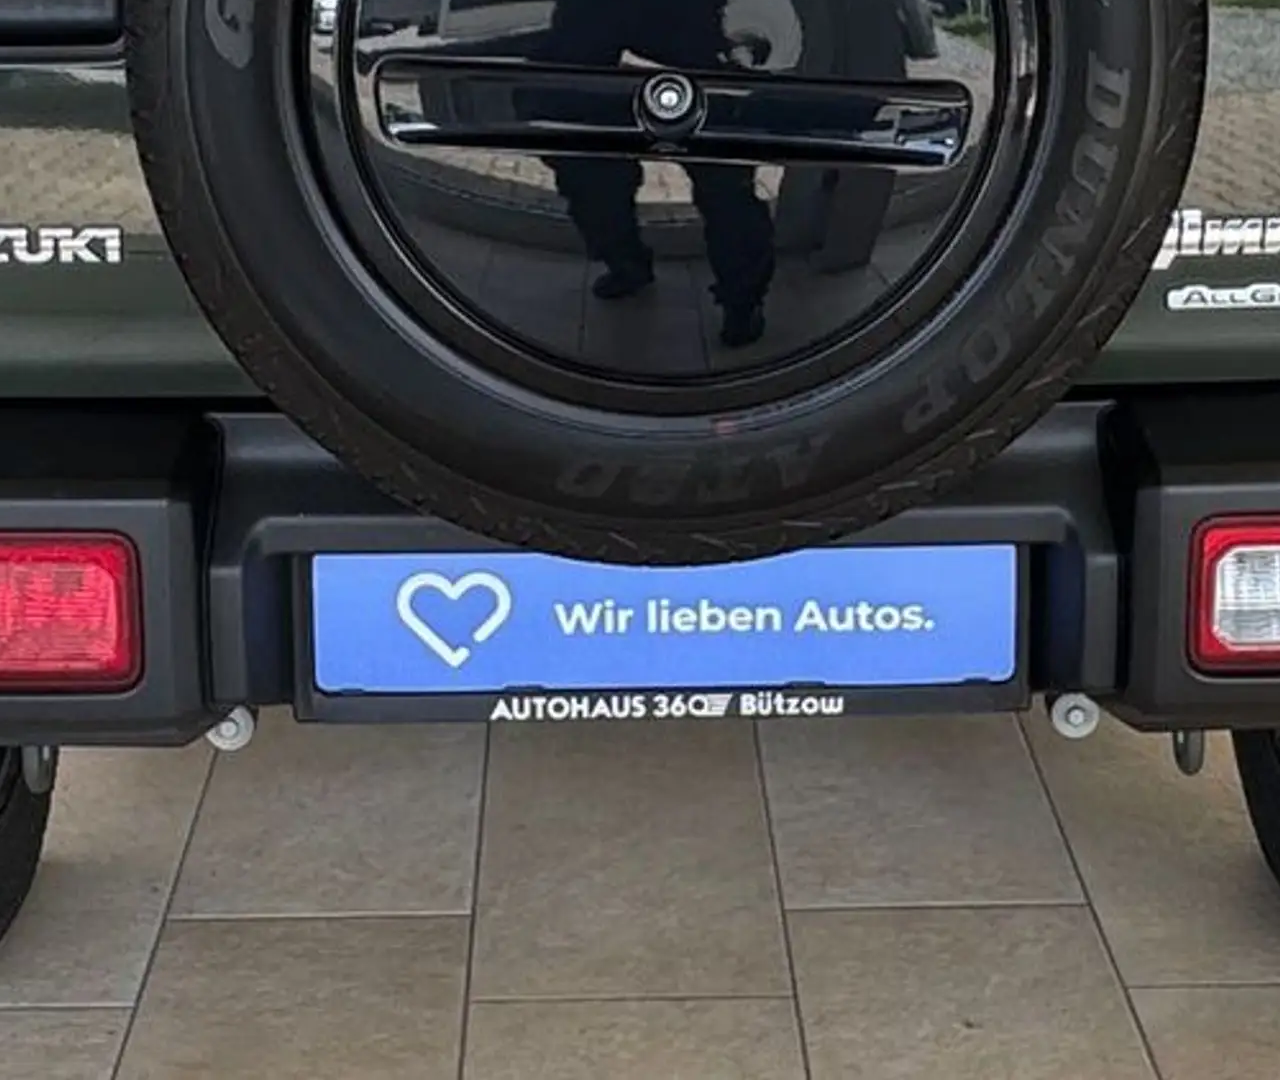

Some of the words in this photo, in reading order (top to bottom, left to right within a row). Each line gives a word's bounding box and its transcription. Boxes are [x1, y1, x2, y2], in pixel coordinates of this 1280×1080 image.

[902, 49, 1131, 434] DUNLOP
[555, 600, 634, 634] Wir
[647, 599, 783, 633] lieben
[793, 601, 937, 633] Autos.
[490, 694, 645, 720] AUTOHAUS
[739, 692, 845, 716] Bützow
